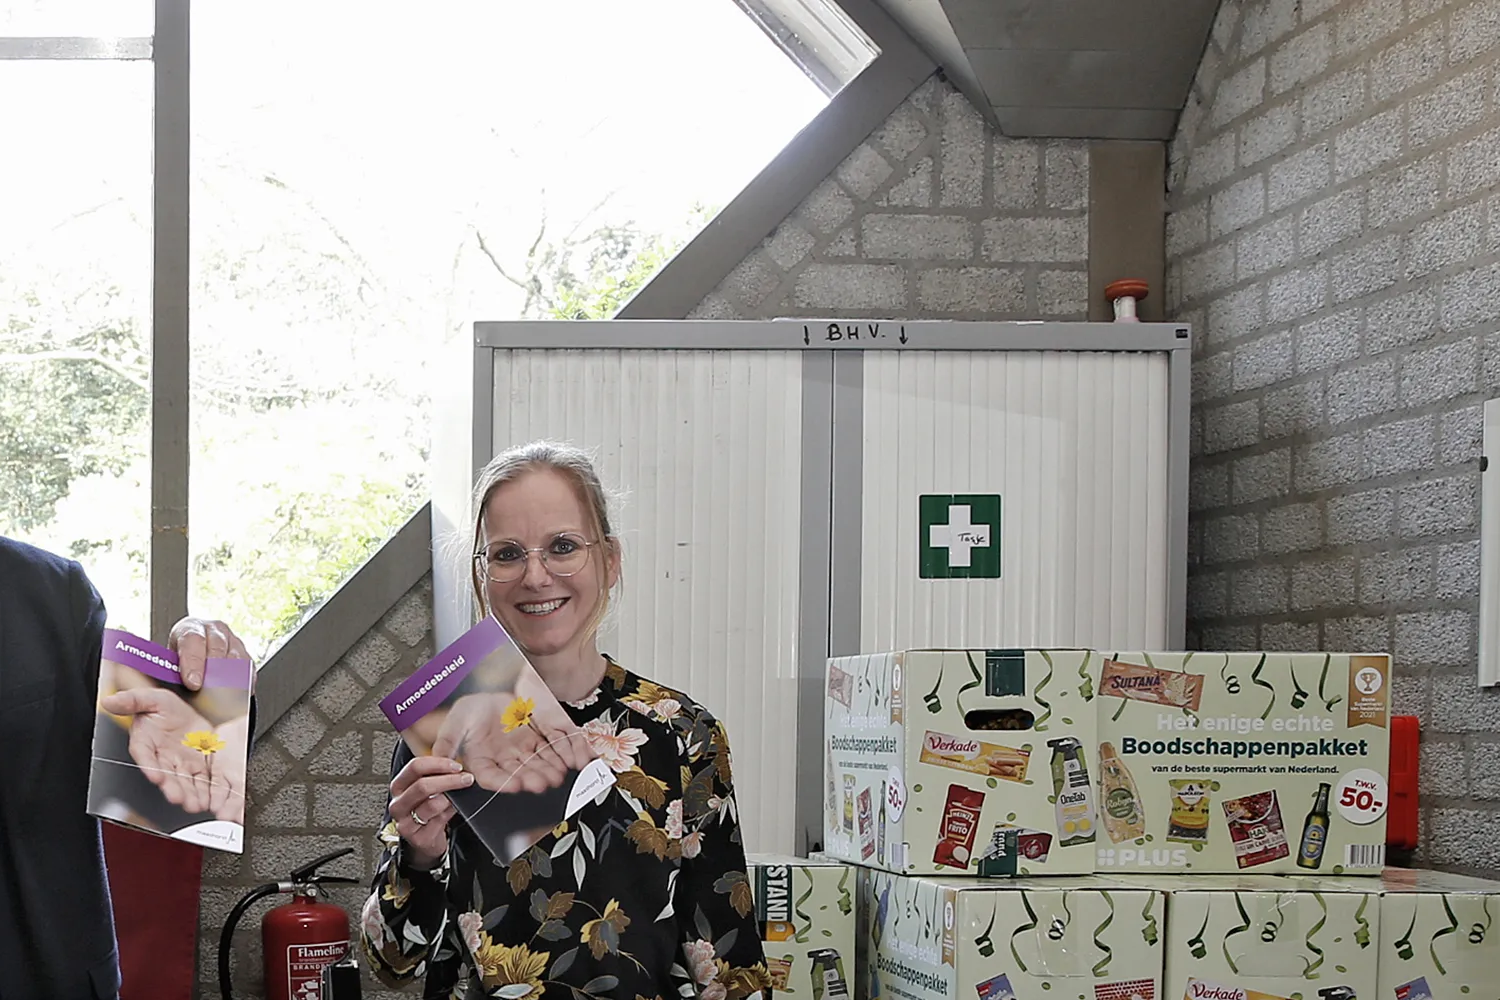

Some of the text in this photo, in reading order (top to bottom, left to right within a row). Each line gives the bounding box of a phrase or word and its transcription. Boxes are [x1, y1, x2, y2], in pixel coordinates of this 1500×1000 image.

[115, 640, 181, 673] Armoedebe
[395, 654, 466, 715] Armoedebeleid
[1111, 674, 1161, 690] SULTANA
[1359, 711, 1376, 719] 2021
[1156, 713, 1334, 735] Het enige echte
[929, 737, 978, 752] Verkade
[1122, 737, 1368, 759] Boodschappenpakket
[1170, 765, 1183, 773] de
[1185, 765, 1211, 774] beste
[1213, 765, 1267, 775] supermarkt
[1269, 766, 1286, 774] van
[1288, 765, 1340, 774] Nederland.
[1060, 793, 1086, 805] OneTab
[1118, 849, 1187, 867] PLUS
[766, 866, 788, 921] STAND
[297, 945, 345, 957] Flameline
[1192, 983, 1244, 1000] Verkade
